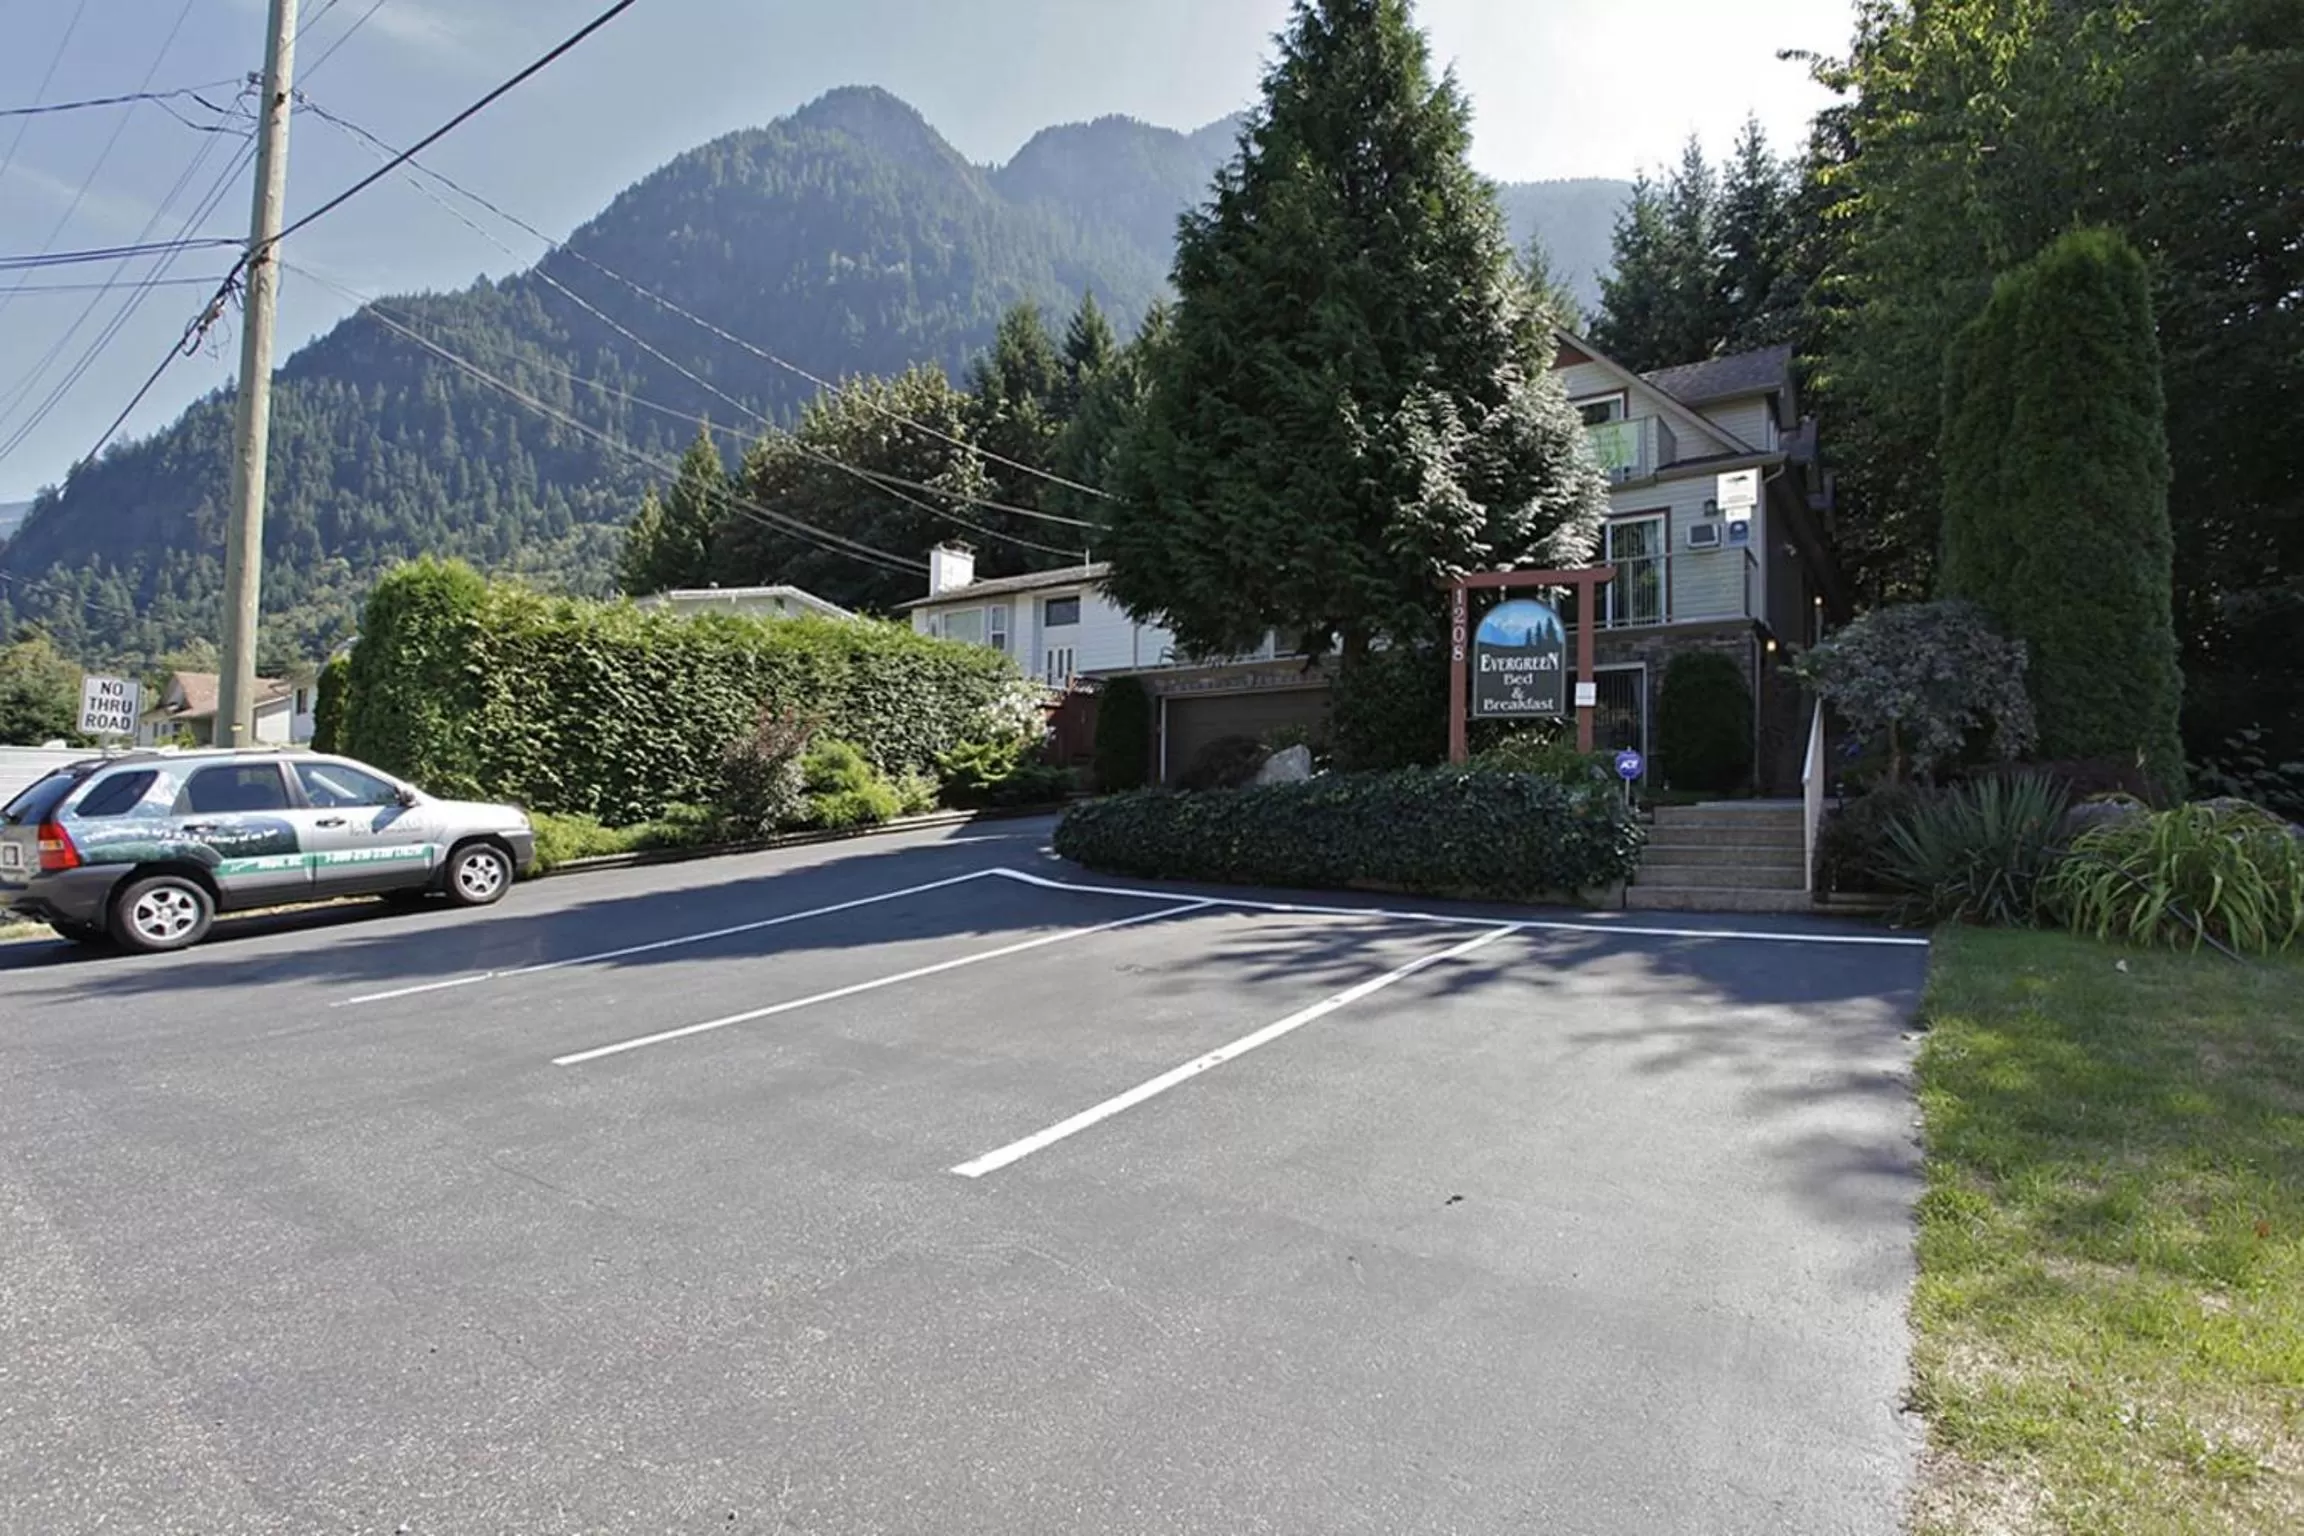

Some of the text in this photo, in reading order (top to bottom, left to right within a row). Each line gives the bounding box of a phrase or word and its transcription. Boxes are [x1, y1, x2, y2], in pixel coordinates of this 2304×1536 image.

[1452, 588, 1466, 661] 1208
[1480, 652, 1560, 671] EVERGREEN
[1504, 672, 1533, 685] Bed
[100, 681, 124, 696] NO
[1511, 686, 1524, 699] &
[88, 696, 133, 714] THRU
[1484, 697, 1554, 711] Breakfast
[85, 714, 131, 730] ROAD
